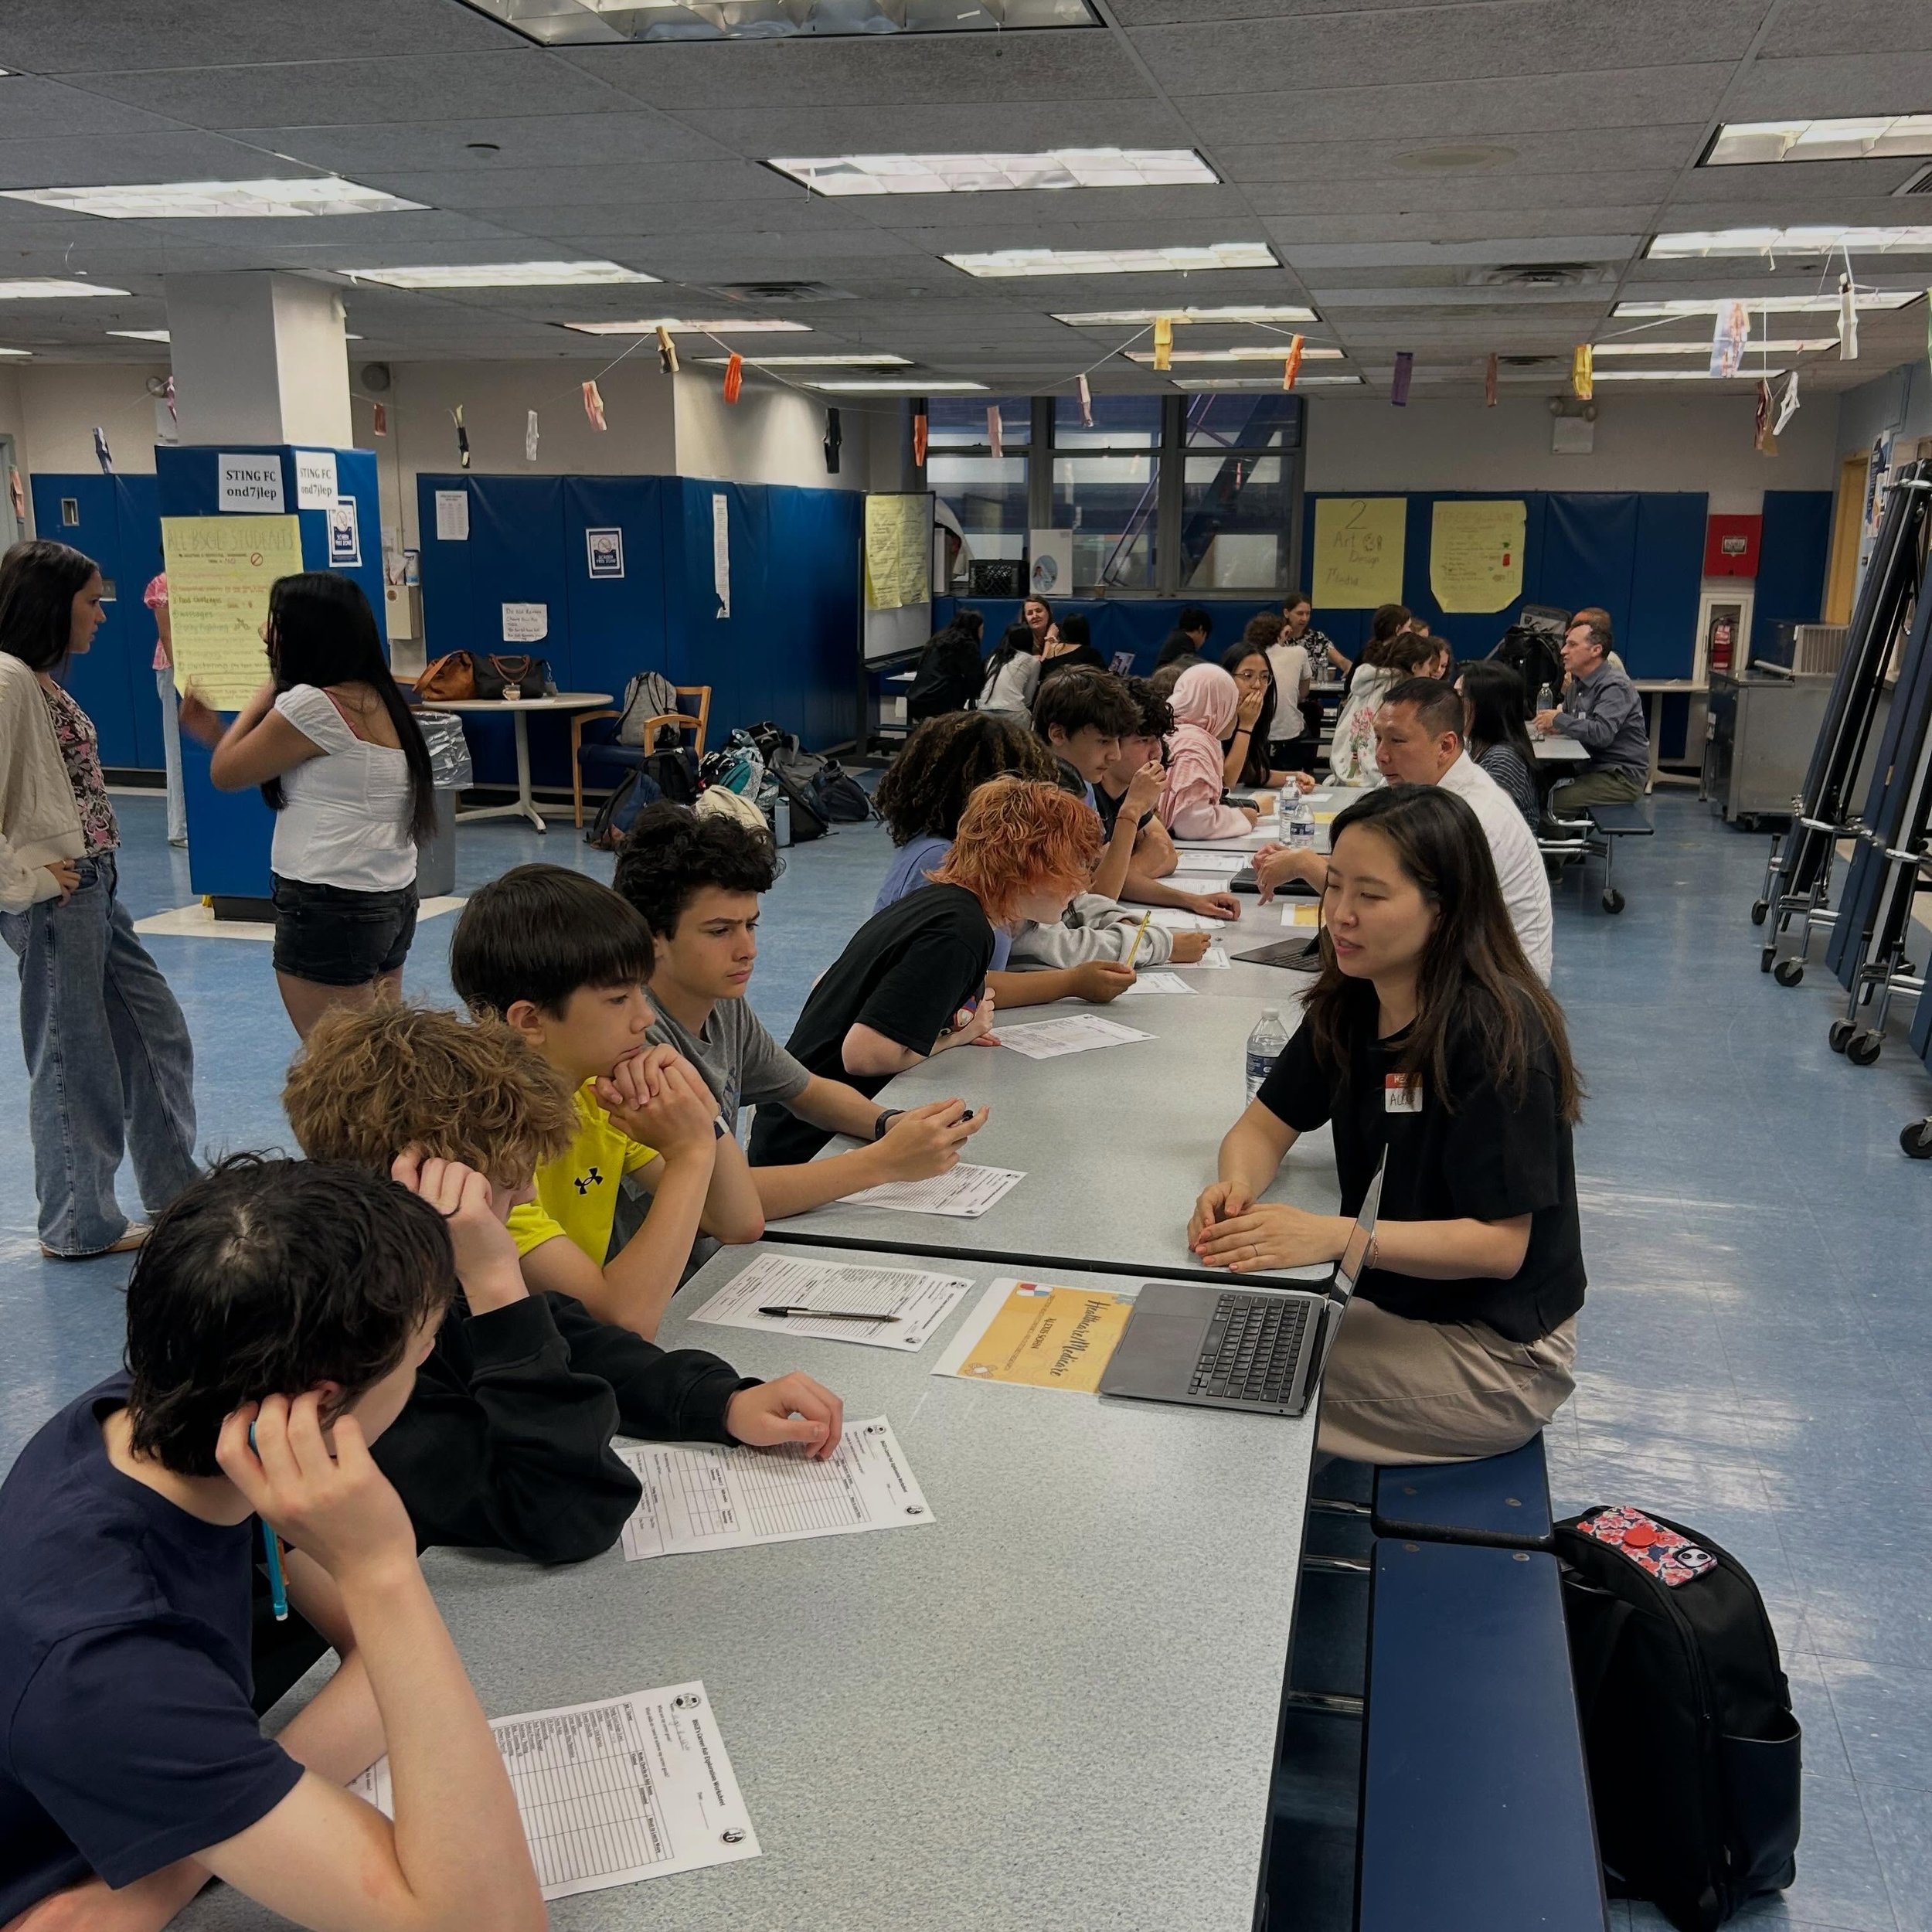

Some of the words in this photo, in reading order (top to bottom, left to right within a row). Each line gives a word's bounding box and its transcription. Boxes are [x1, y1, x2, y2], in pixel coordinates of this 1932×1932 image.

[226, 470, 260, 481] STING
[264, 471, 276, 481] FC
[300, 468, 319, 479] STING
[321, 468, 332, 479] FC
[226, 487, 277, 500] ond7jlep
[1345, 500, 1367, 529] 2
[1333, 532, 1355, 548] Art
[1348, 550, 1379, 569] Design
[1326, 568, 1359, 586] Media
[1050, 1300, 1111, 1376] Healthcare/Medicare
[696, 1733, 706, 1747] Career
[701, 1747, 709, 1756] Fair
[702, 1755, 718, 1781] Exploration
[713, 1781, 726, 1806] Worksheet
